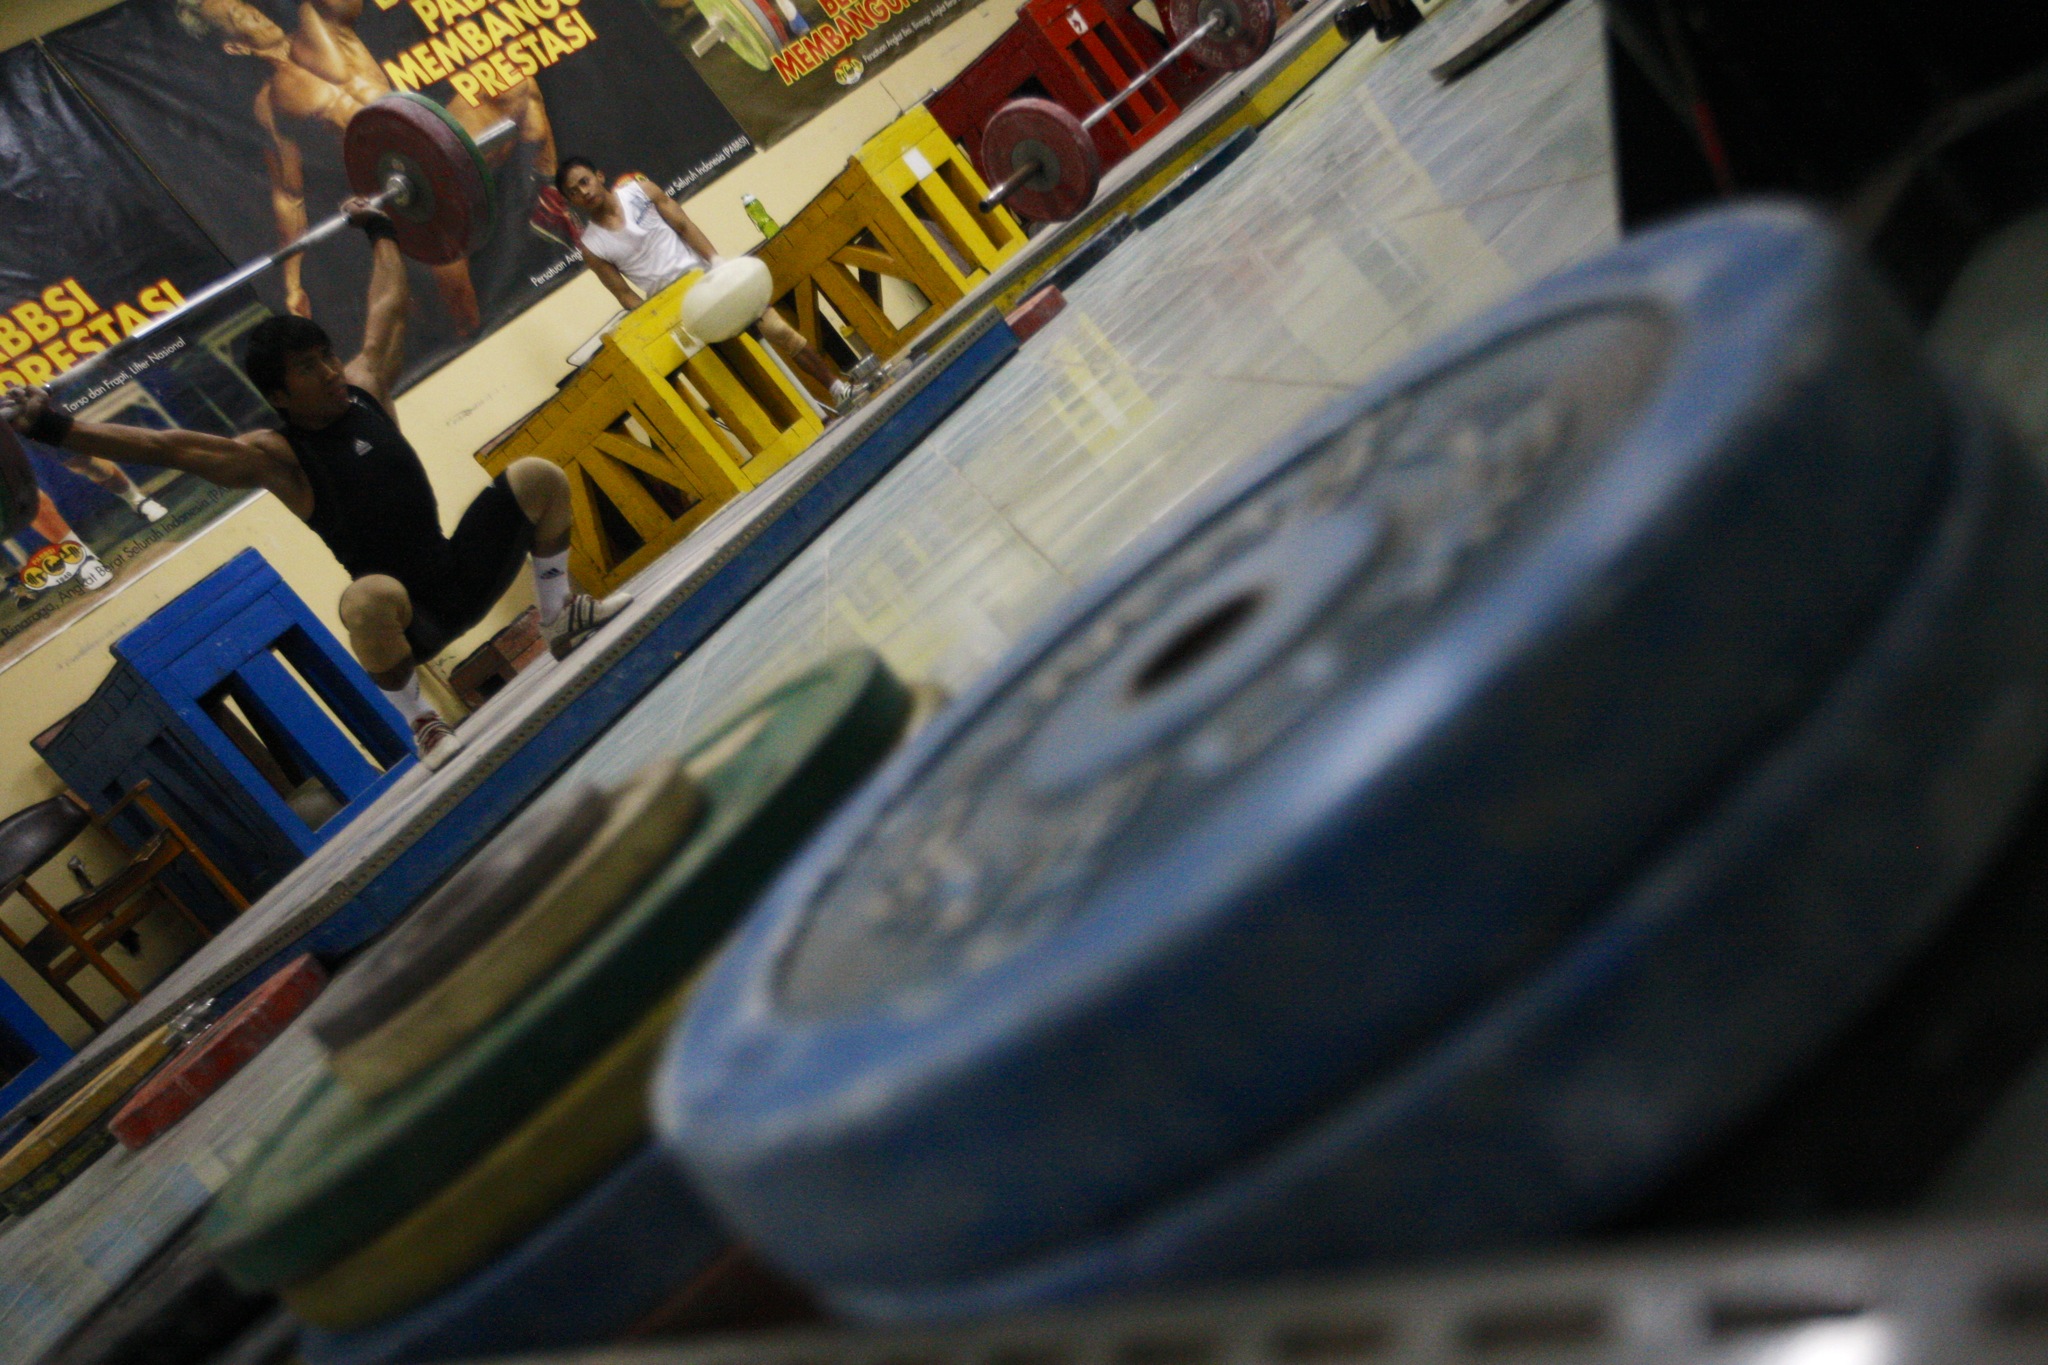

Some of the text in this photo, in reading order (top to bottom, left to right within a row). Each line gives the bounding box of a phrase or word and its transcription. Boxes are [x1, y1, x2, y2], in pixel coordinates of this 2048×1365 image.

[449, 9, 597, 108] PRESTASI
[529, 259, 568, 287] Persatuan
[673, 167, 698, 192] Seluruh
[696, 154, 726, 180] Indonesia
[723, 135, 749, 160] (PABBSI)
[0, 277, 101, 365] BBSI
[62, 396, 90, 413] Tarso
[88, 385, 105, 400] dan
[129, 358, 150, 375] Lifter
[148, 336, 187, 364] Nasional
[57, 573, 97, 604] Angkat
[95, 554, 125, 577] Berat
[123, 528, 164, 558] Seluruh
[160, 498, 210, 533] Indonesia
